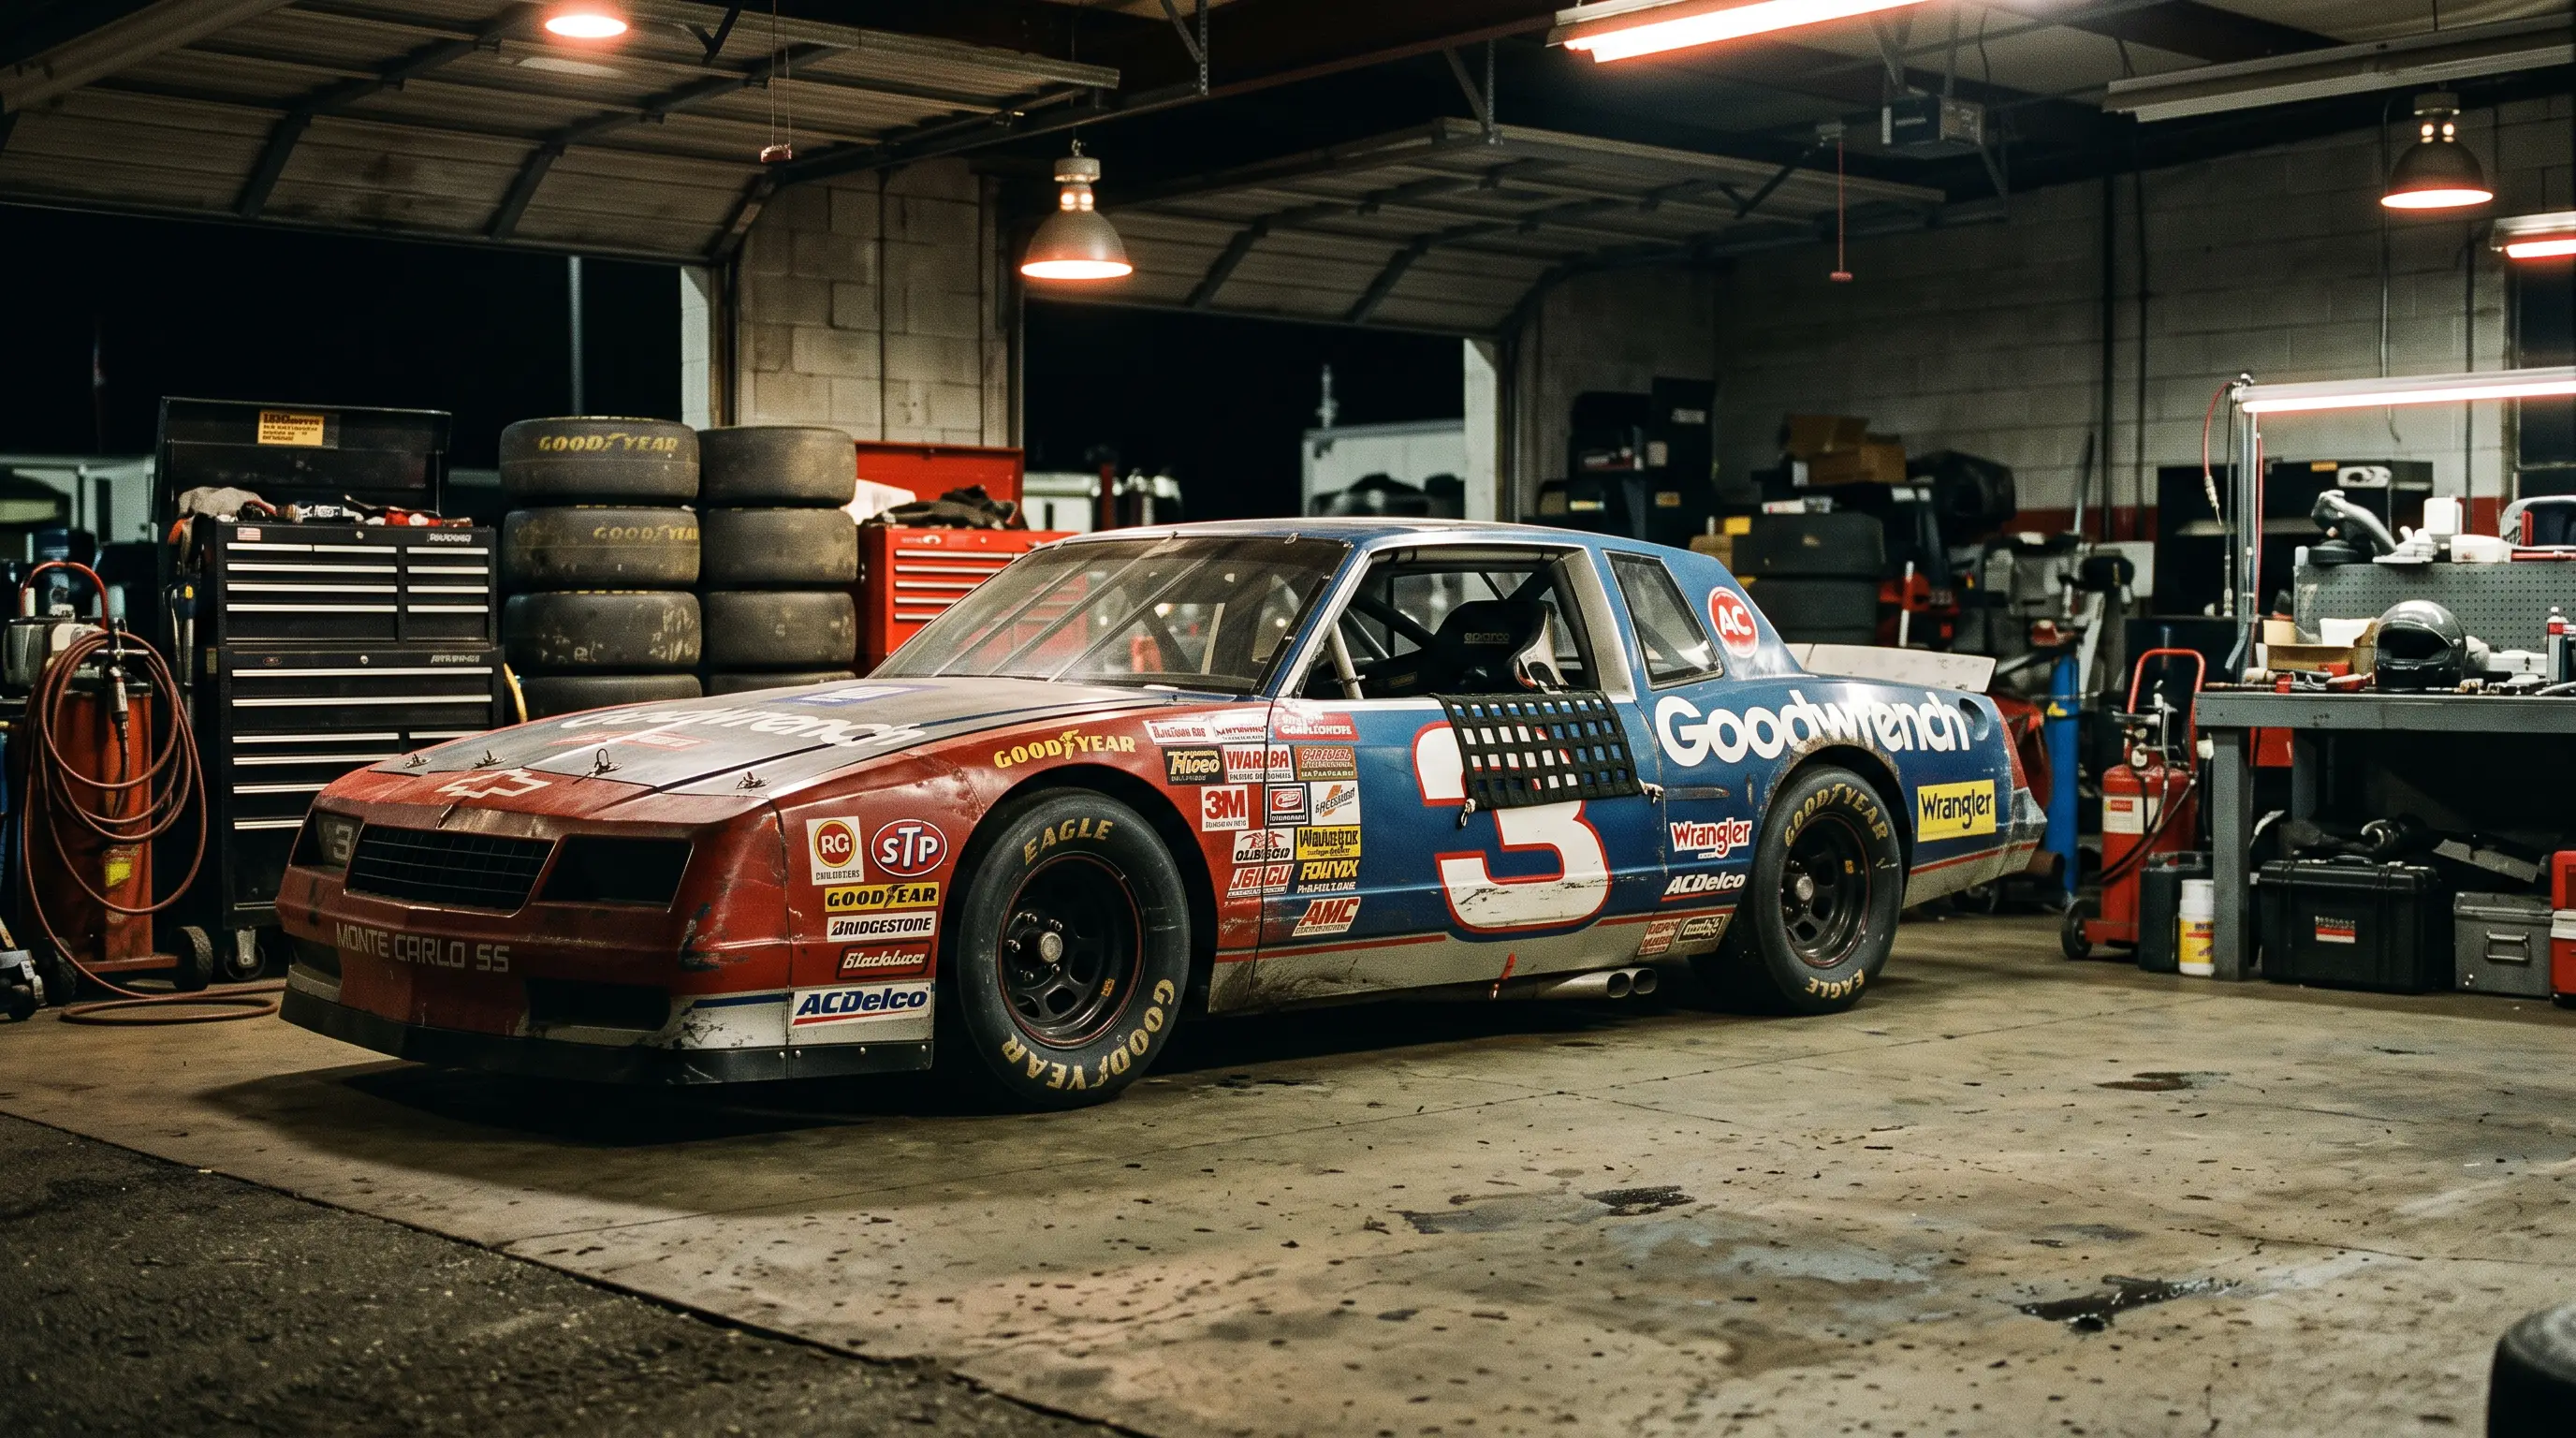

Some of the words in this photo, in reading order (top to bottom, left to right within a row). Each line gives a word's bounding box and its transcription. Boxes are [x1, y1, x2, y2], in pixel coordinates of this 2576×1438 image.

[1718, 605, 1752, 636] AC
[1655, 689, 1971, 767] Goodwrench
[993, 729, 1136, 770] GOODYEAR
[1205, 790, 1247, 820] 3M
[1783, 783, 1891, 848] GOODYEAR
[1920, 788, 1993, 830] Wrangler
[332, 825, 354, 861] 3
[880, 825, 939, 868] STP
[1022, 816, 1115, 867] EAGLE
[1410, 719, 1614, 935] 3
[1673, 817, 1750, 858] Wrangler
[1663, 872, 1747, 896] ACDelco
[830, 917, 933, 936] BRIDGESTONE
[1298, 898, 1360, 927] AMC
[335, 921, 390, 959] MONTE
[394, 933, 466, 969] CARLO
[476, 943, 511, 973] SS
[795, 986, 929, 1017] ACDelco
[1805, 967, 1866, 1000] EAGLE
[1001, 978, 1176, 1092] GOODYEAR
